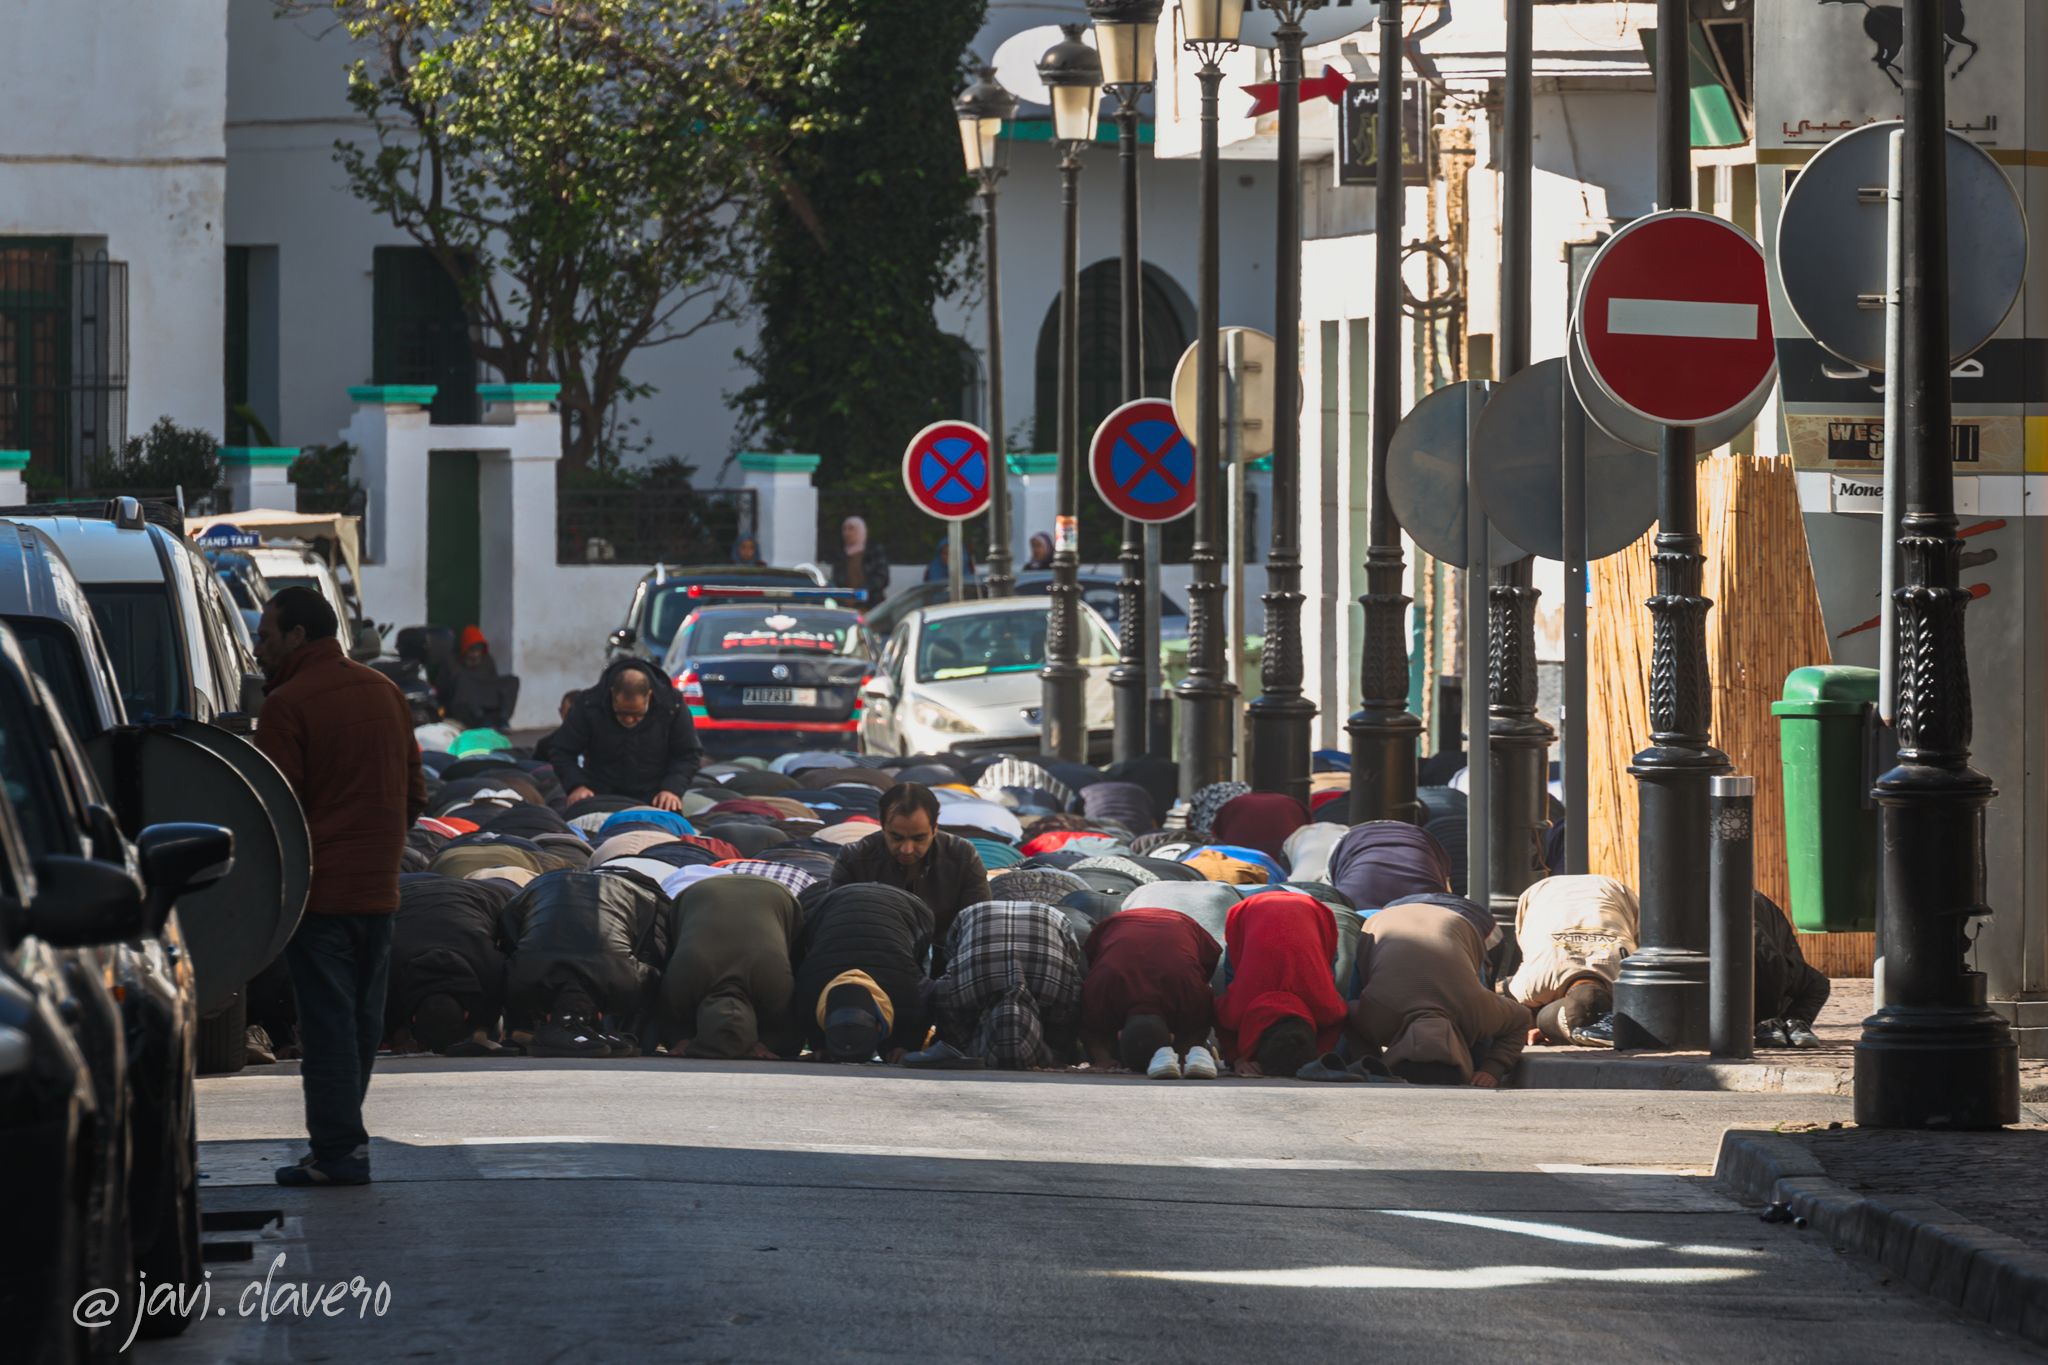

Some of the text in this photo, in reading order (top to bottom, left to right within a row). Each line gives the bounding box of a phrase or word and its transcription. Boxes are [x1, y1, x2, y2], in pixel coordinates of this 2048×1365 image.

[1948, 115, 1997, 134] البن
[1831, 424, 1884, 441] WES
[1868, 443, 1884, 459] U
[1839, 483, 1884, 500] Mone
[199, 535, 253, 547] RAND TAXI
